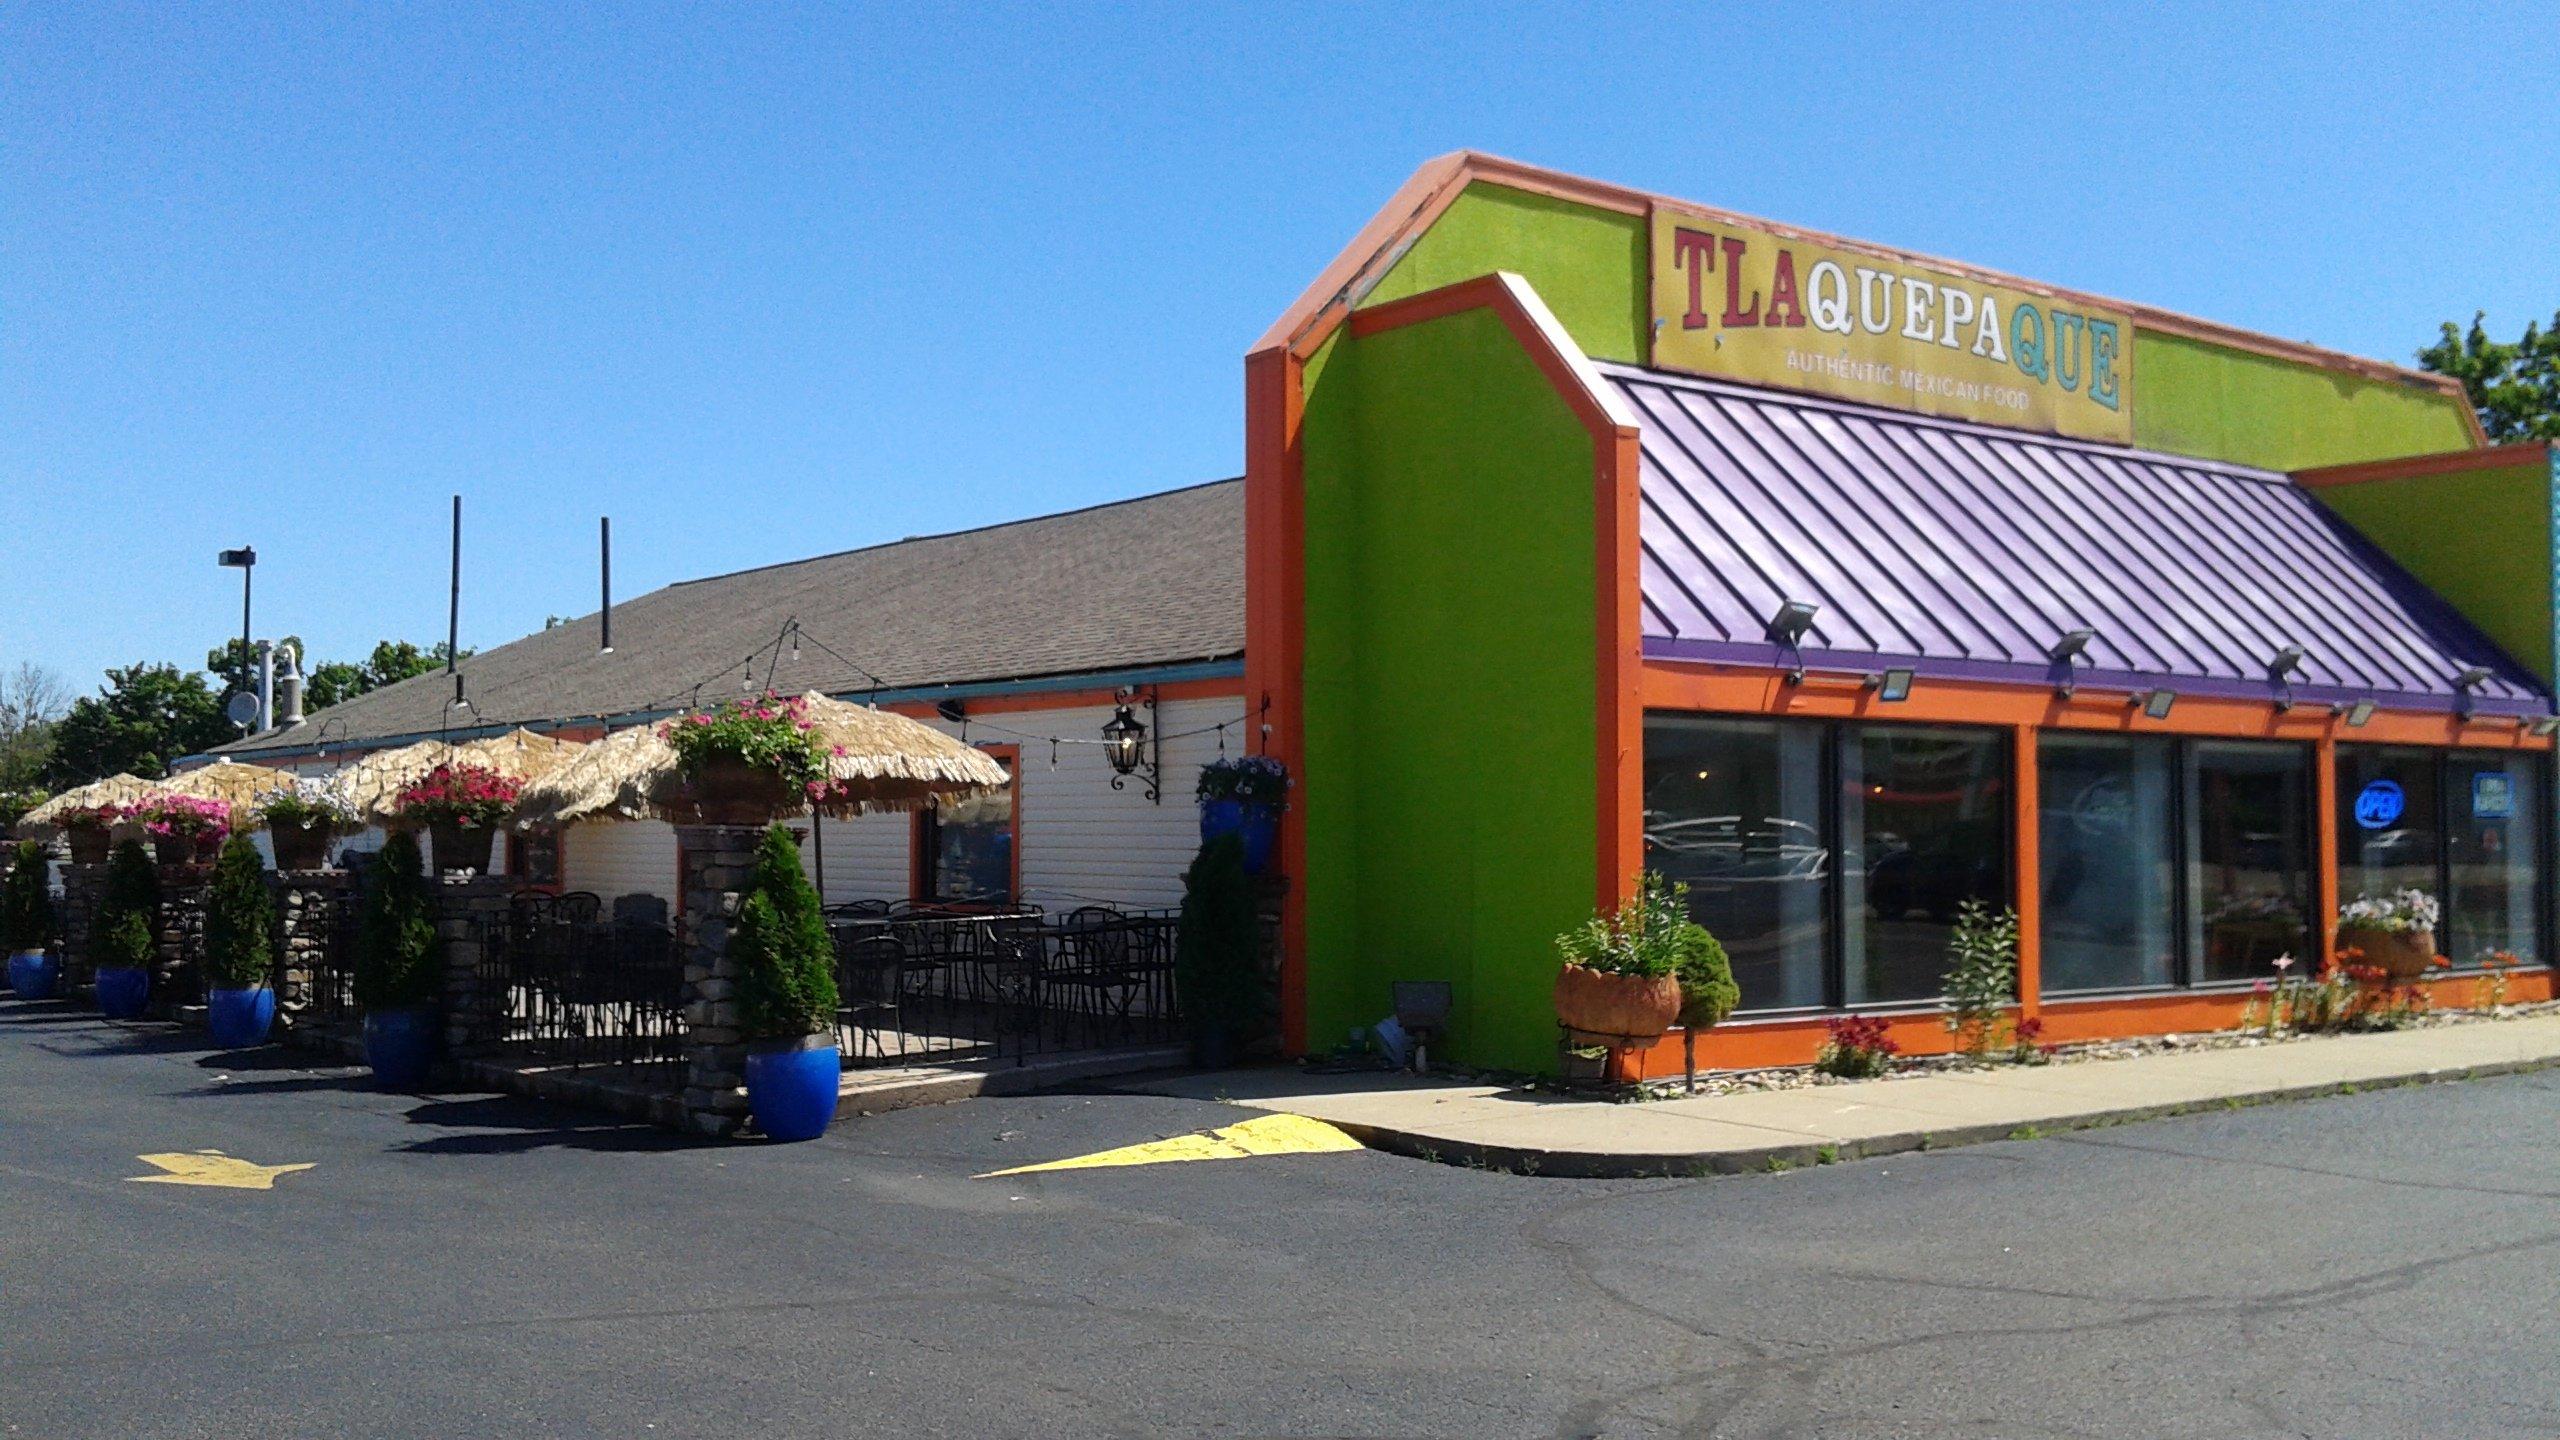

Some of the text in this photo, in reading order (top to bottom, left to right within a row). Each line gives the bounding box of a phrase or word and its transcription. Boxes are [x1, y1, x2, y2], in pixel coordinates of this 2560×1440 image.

[1674, 226, 2118, 411] TLAQUEPAQUE
[1786, 350, 2030, 410] AUTHENTIC MEXICAN FOOD
